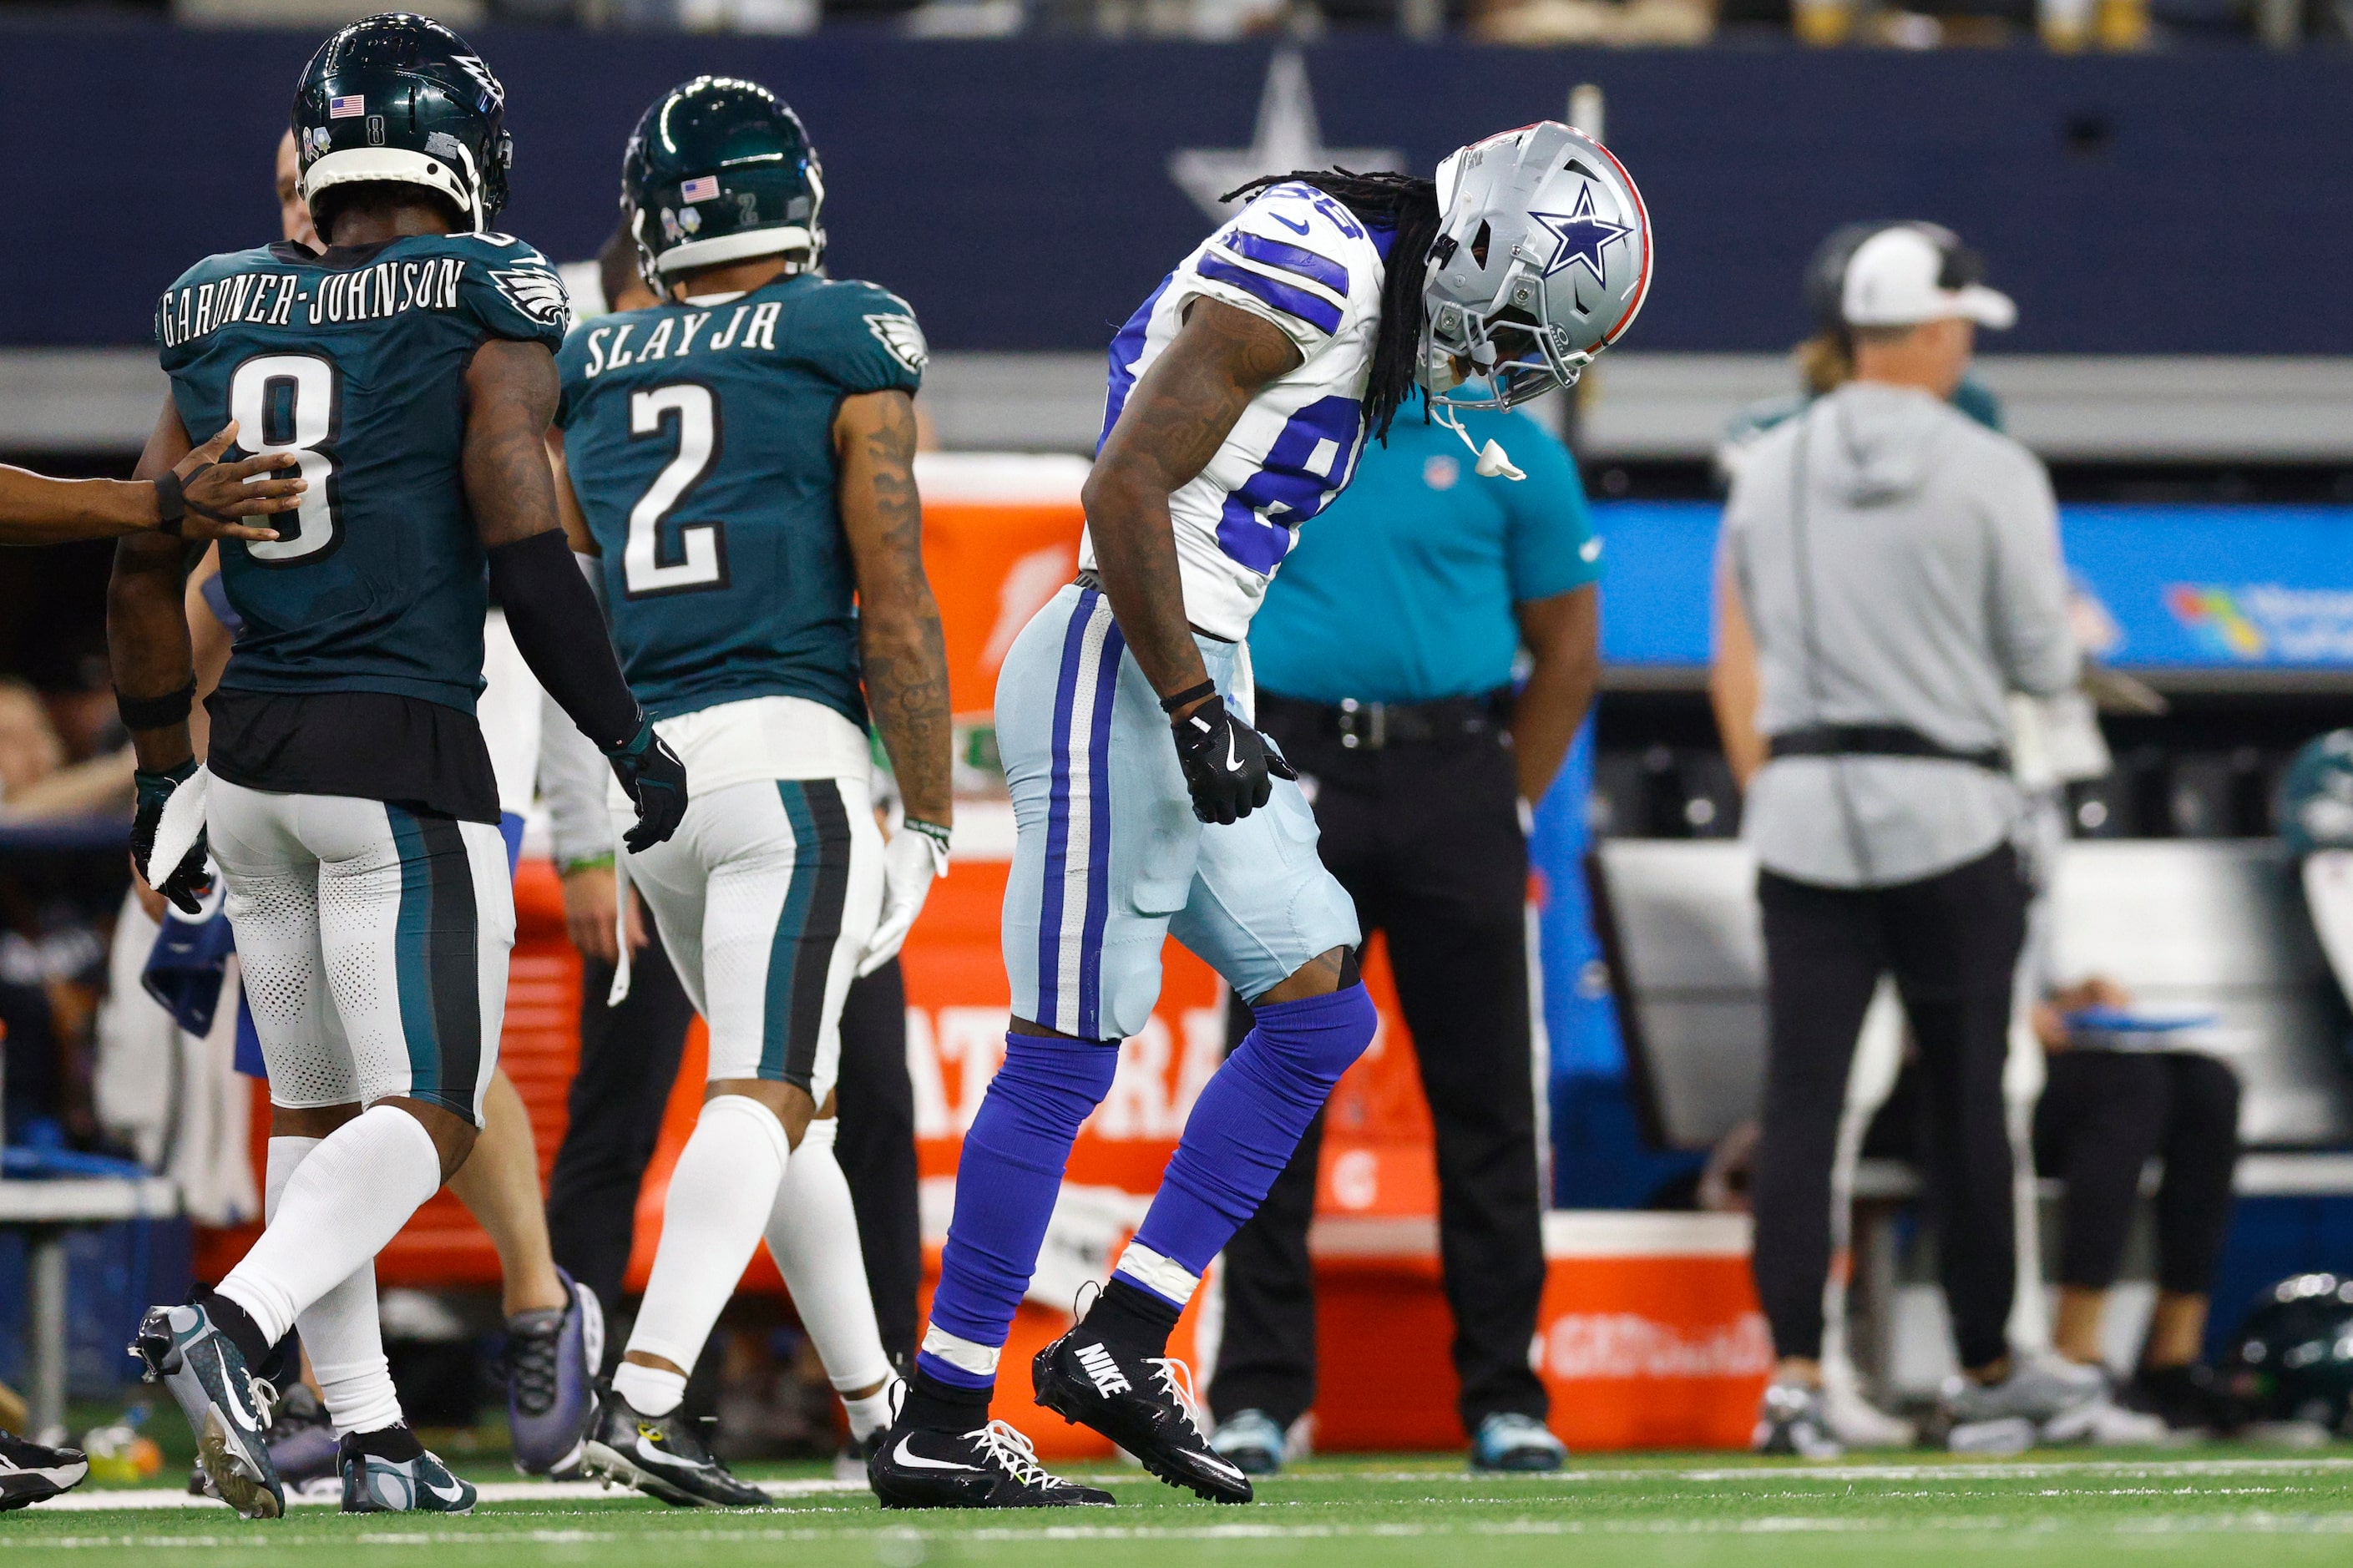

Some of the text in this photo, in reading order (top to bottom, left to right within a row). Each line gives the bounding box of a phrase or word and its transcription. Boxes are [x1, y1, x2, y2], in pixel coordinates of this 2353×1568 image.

[367, 114, 386, 146] 8
[737, 193, 759, 225] 2
[161, 257, 466, 349] GARDNER-JOHNSON
[584, 301, 782, 379] SLAY JR
[227, 352, 340, 564] 8
[624, 382, 724, 597] 2
[1073, 1342, 1132, 1399] NIKE
